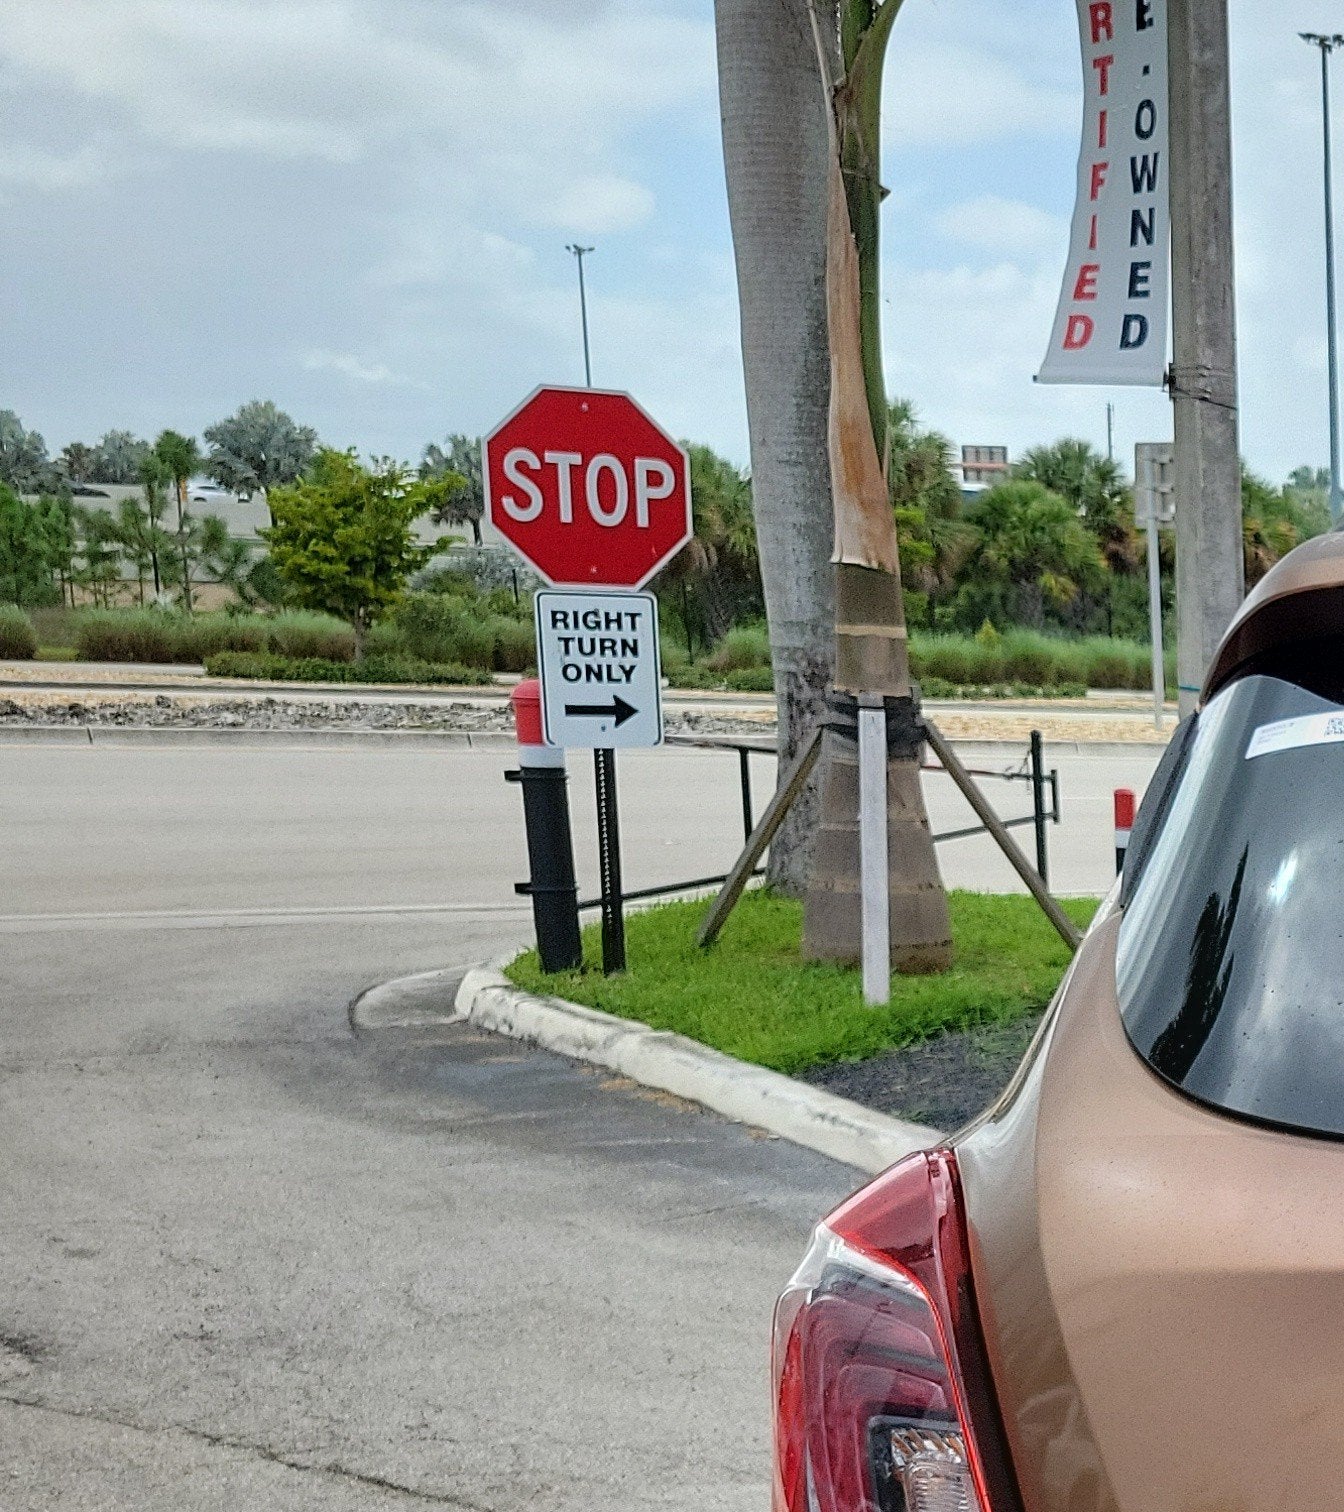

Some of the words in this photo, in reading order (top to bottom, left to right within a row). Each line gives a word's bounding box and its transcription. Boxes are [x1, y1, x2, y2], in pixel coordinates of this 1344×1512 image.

[501, 446, 676, 529] STOP
[550, 609, 642, 632] RIGHT
[557, 636, 639, 659] TURN
[561, 662, 637, 684] ONLY
